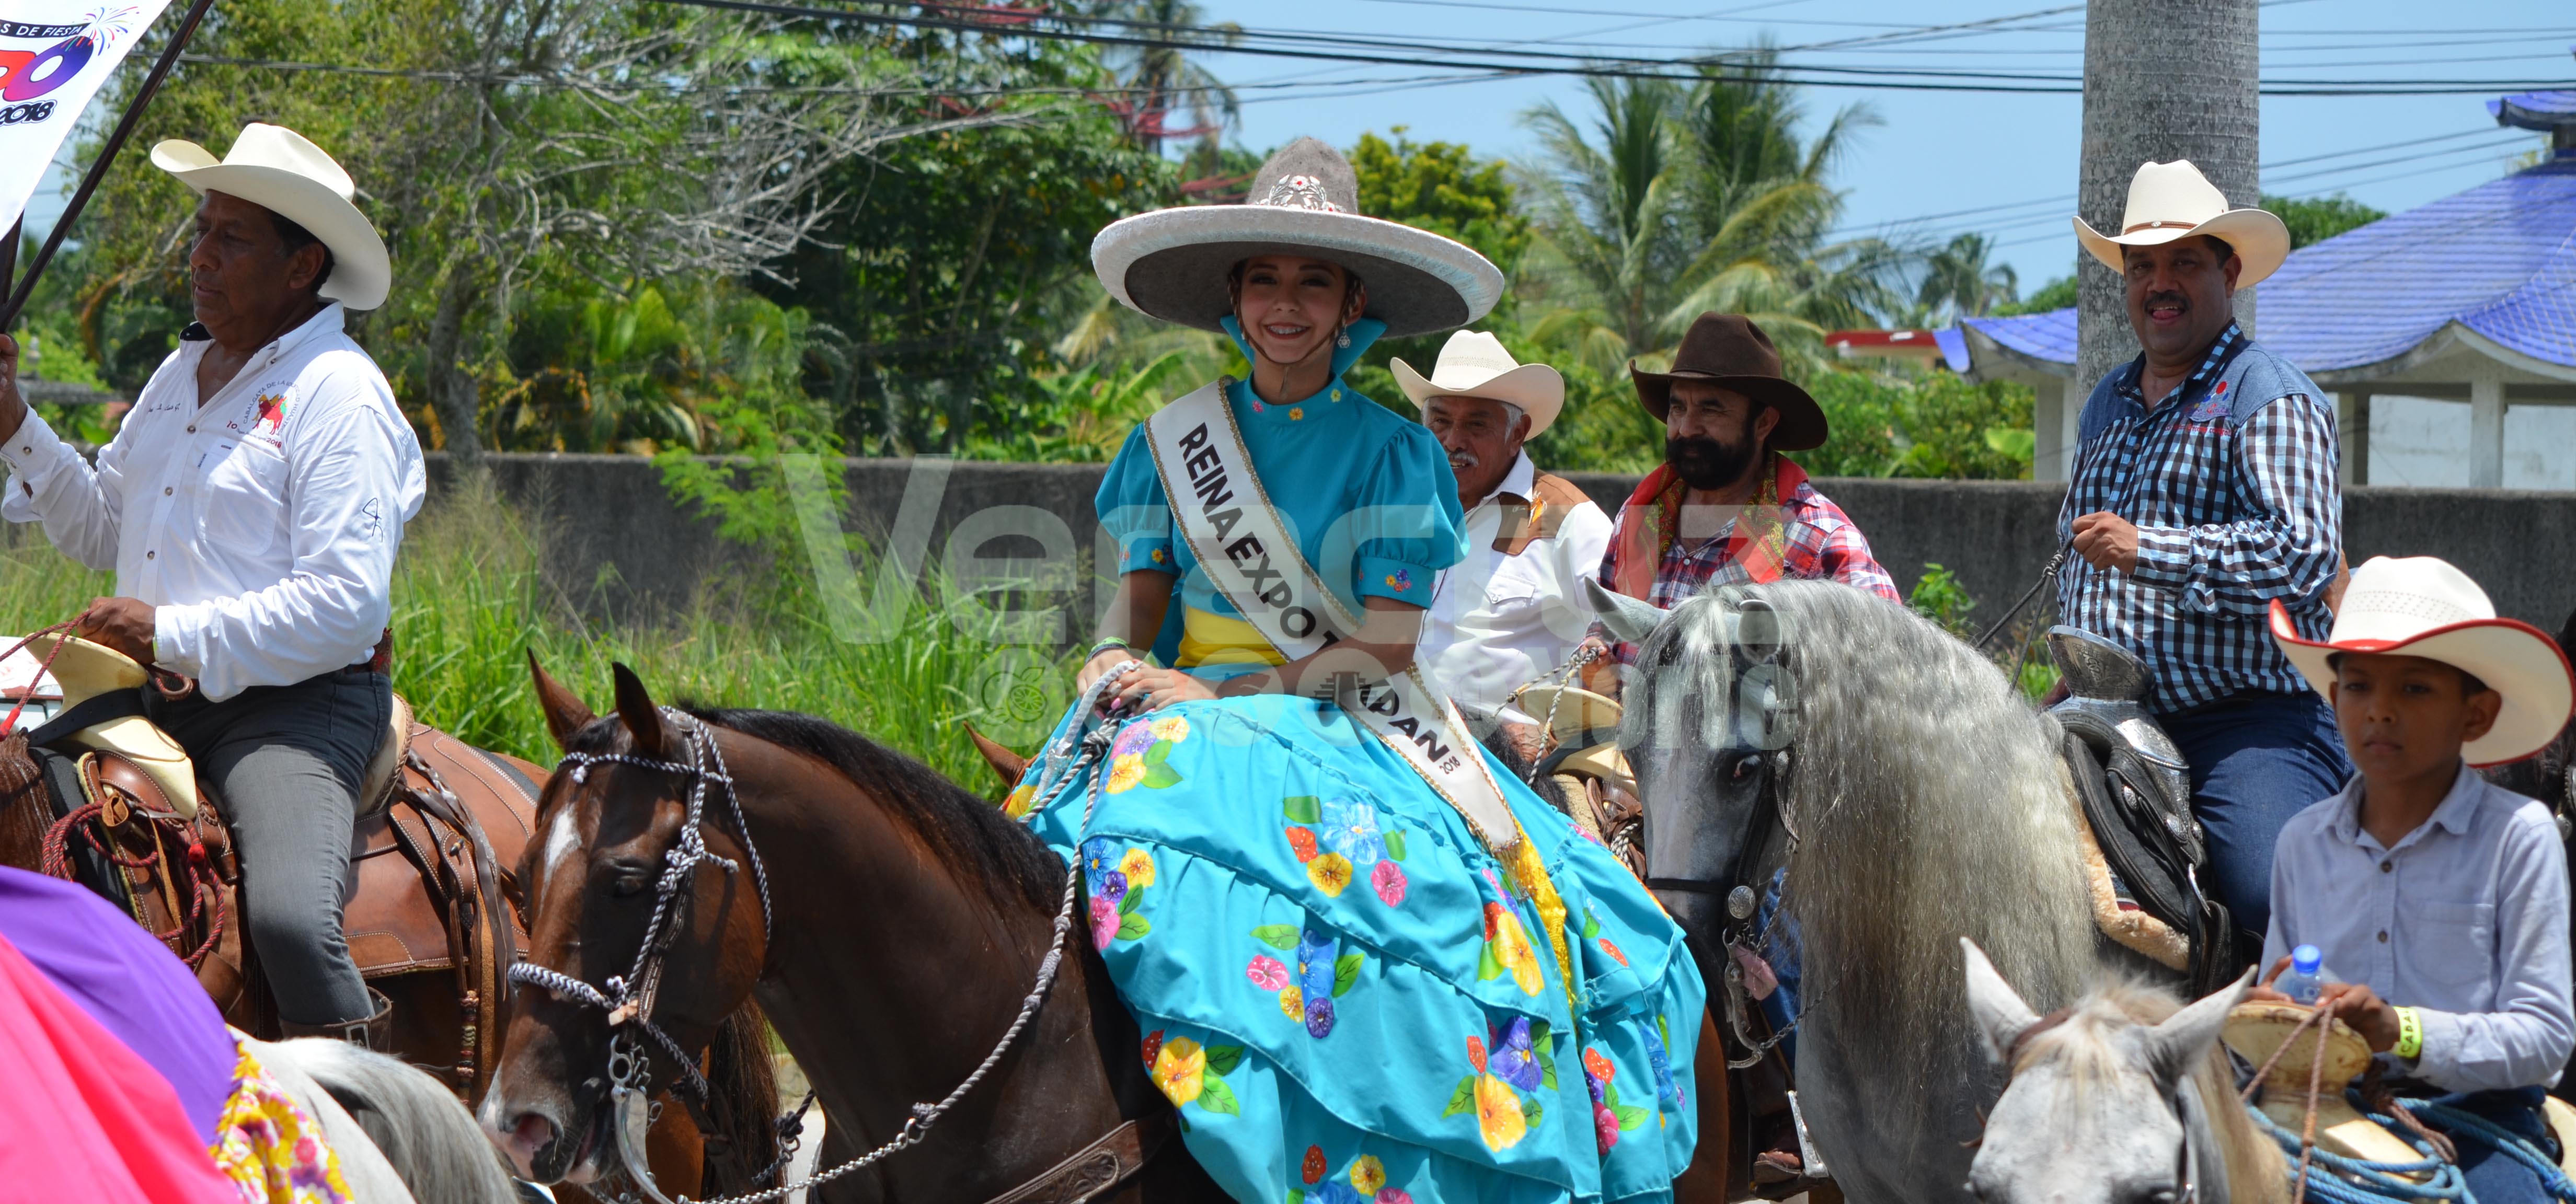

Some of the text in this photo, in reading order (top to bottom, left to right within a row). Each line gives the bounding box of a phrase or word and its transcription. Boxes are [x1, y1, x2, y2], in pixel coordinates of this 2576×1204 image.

[0, 23, 83, 37] S DE FIESTA
[226, 420, 238, 429] 10
[266, 437, 282, 448] 2018
[1178, 421, 1244, 543] REINA
[1224, 531, 1317, 639] EXPO
[1439, 756, 1461, 775] 2018
